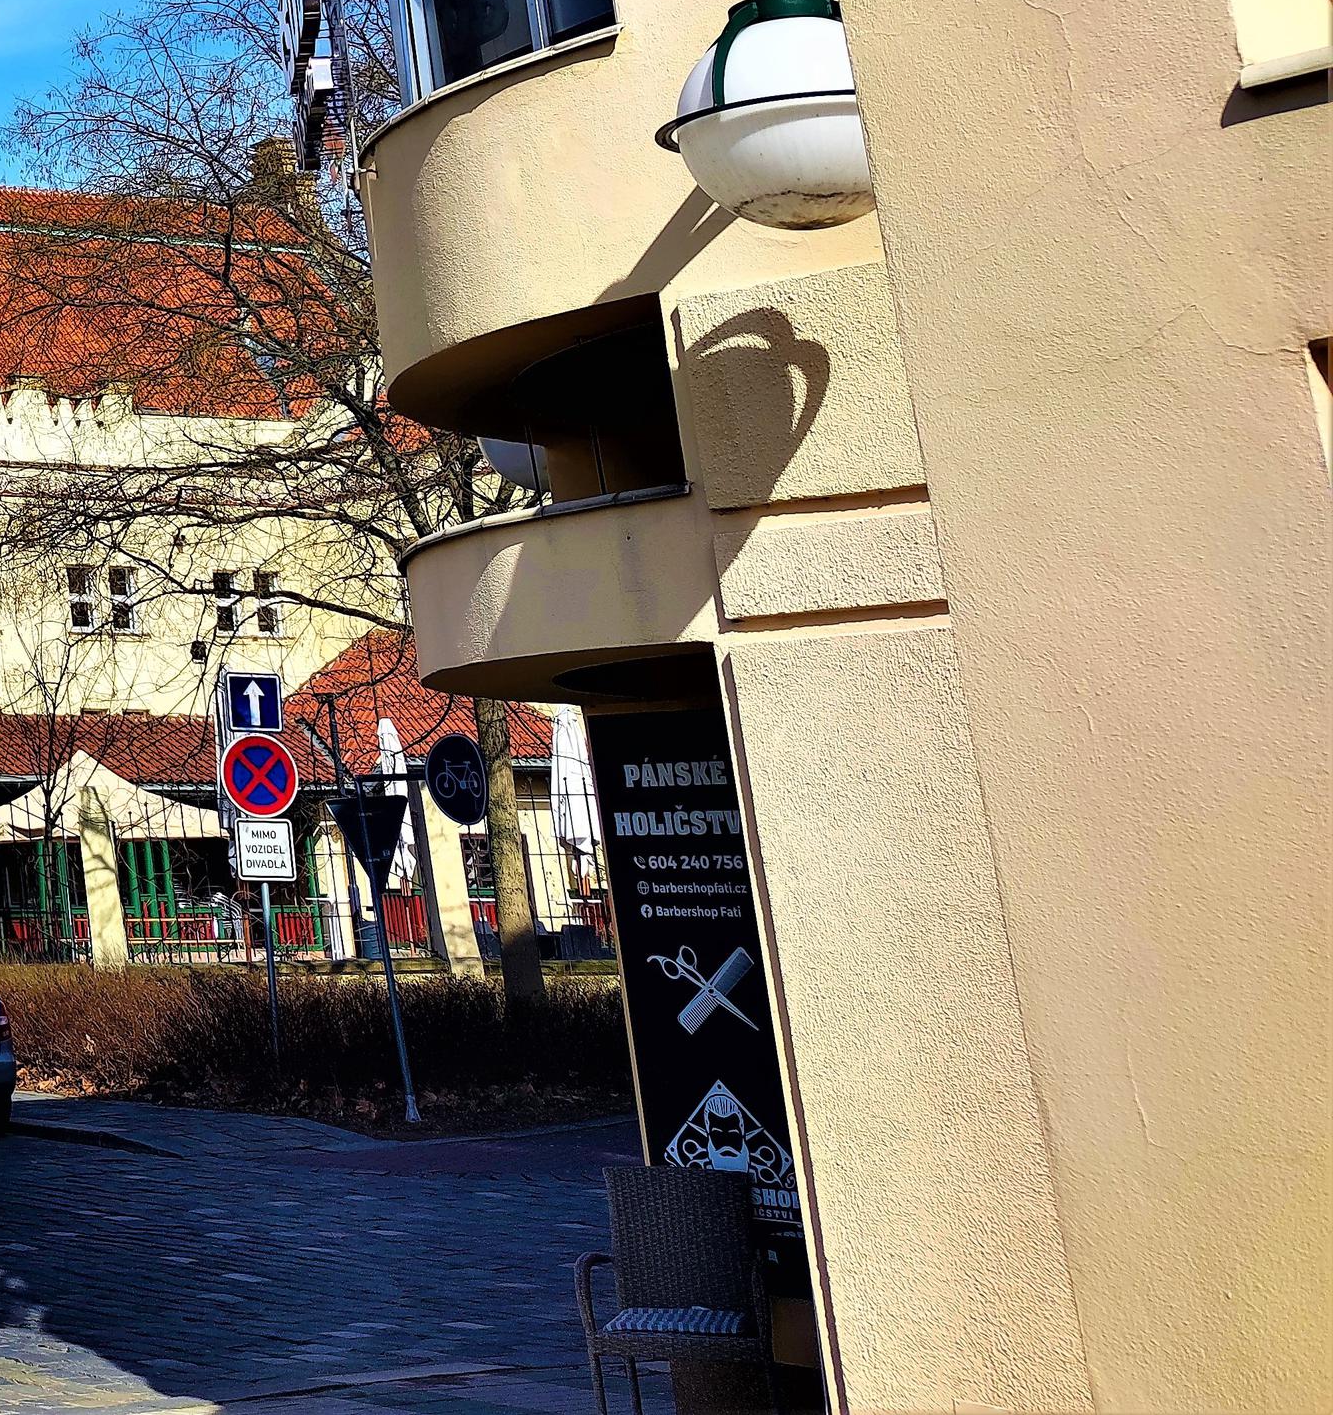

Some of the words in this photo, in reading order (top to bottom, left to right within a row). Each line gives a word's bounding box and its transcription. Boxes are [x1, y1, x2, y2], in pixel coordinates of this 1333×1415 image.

[623, 754, 728, 788] PÁNSKÉ
[614, 804, 740, 836] HOLIČSTV
[251, 830, 277, 840] MIMO
[245, 844, 286, 854] VOZIDEL
[246, 859, 287, 869] DIVADLA
[648, 855, 677, 869] 604
[680, 855, 710, 869] 240
[713, 855, 744, 869] 756
[652, 882, 748, 896] barbershopfati.cz
[656, 906, 719, 919] Barbershop
[720, 906, 742, 918] Fati
